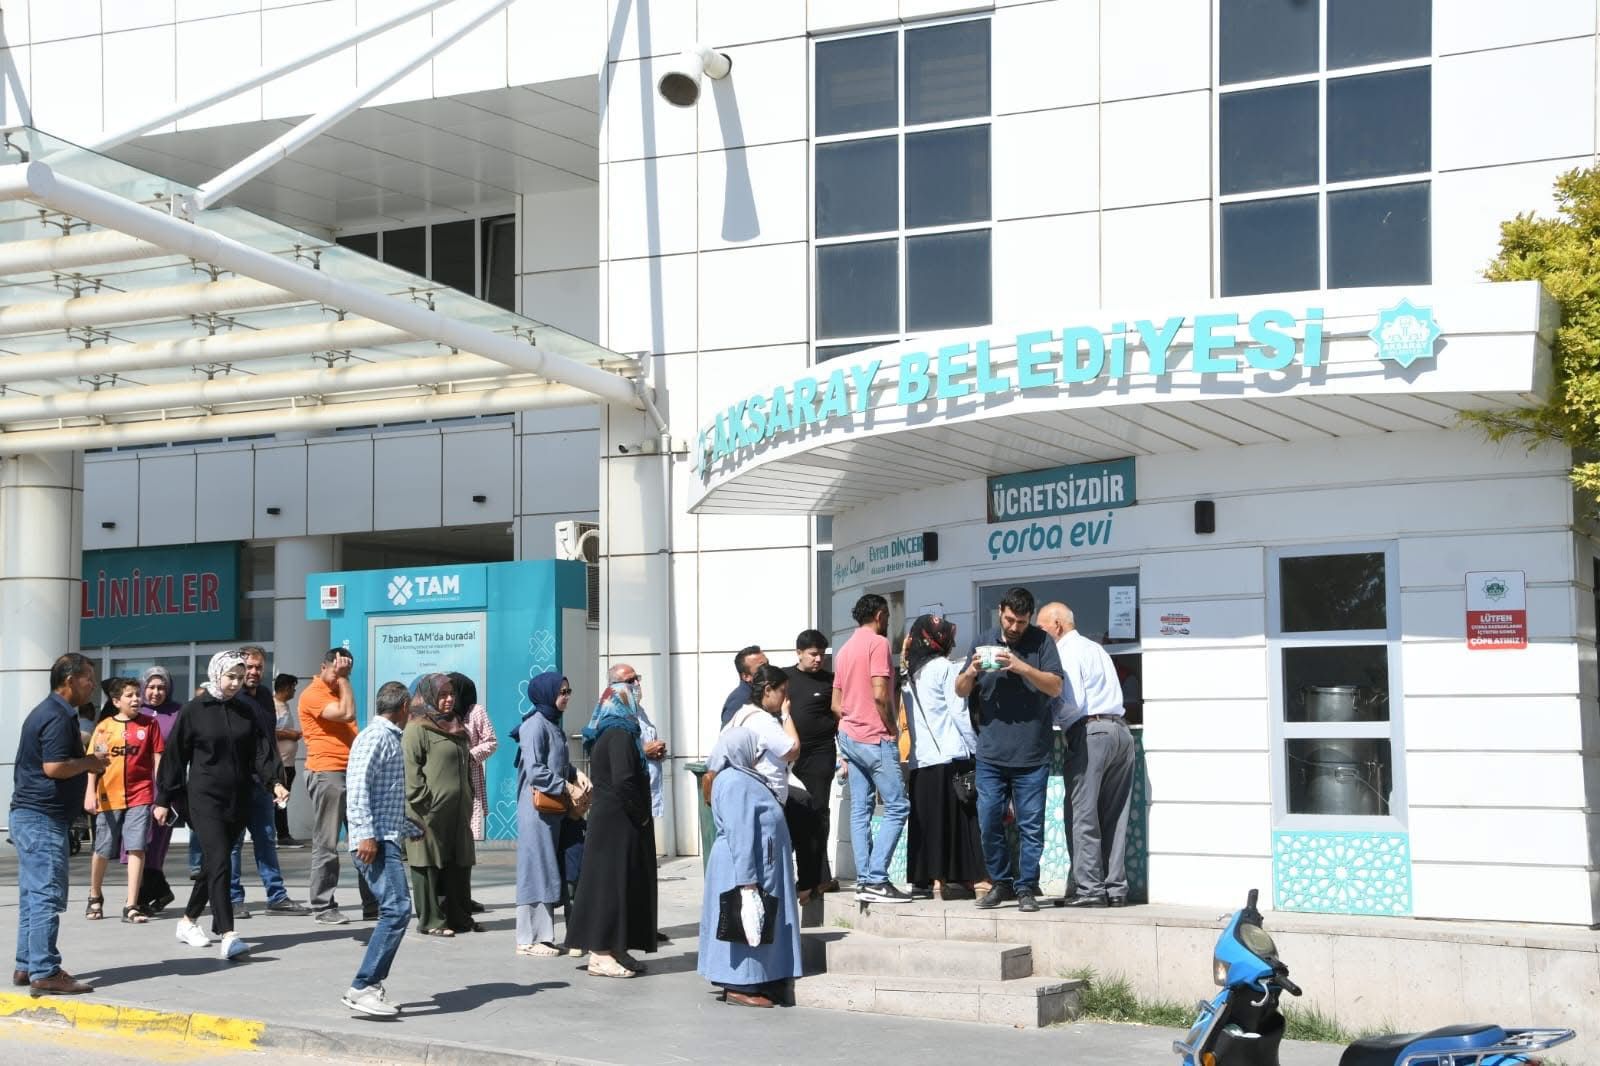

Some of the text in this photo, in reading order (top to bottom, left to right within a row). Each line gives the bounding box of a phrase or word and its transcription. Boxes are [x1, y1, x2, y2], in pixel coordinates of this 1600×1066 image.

[712, 307, 1325, 463] AKSARAY BELEDİYESİ
[993, 469, 1125, 517] ÜCRETSİZDİR
[988, 511, 1114, 561] çorba evi
[415, 574, 460, 597] TAM
[1480, 613, 1512, 623] LÜTFEN
[381, 634, 388, 644] 7
[388, 633, 413, 644] banka
[445, 630, 476, 641] burada!
